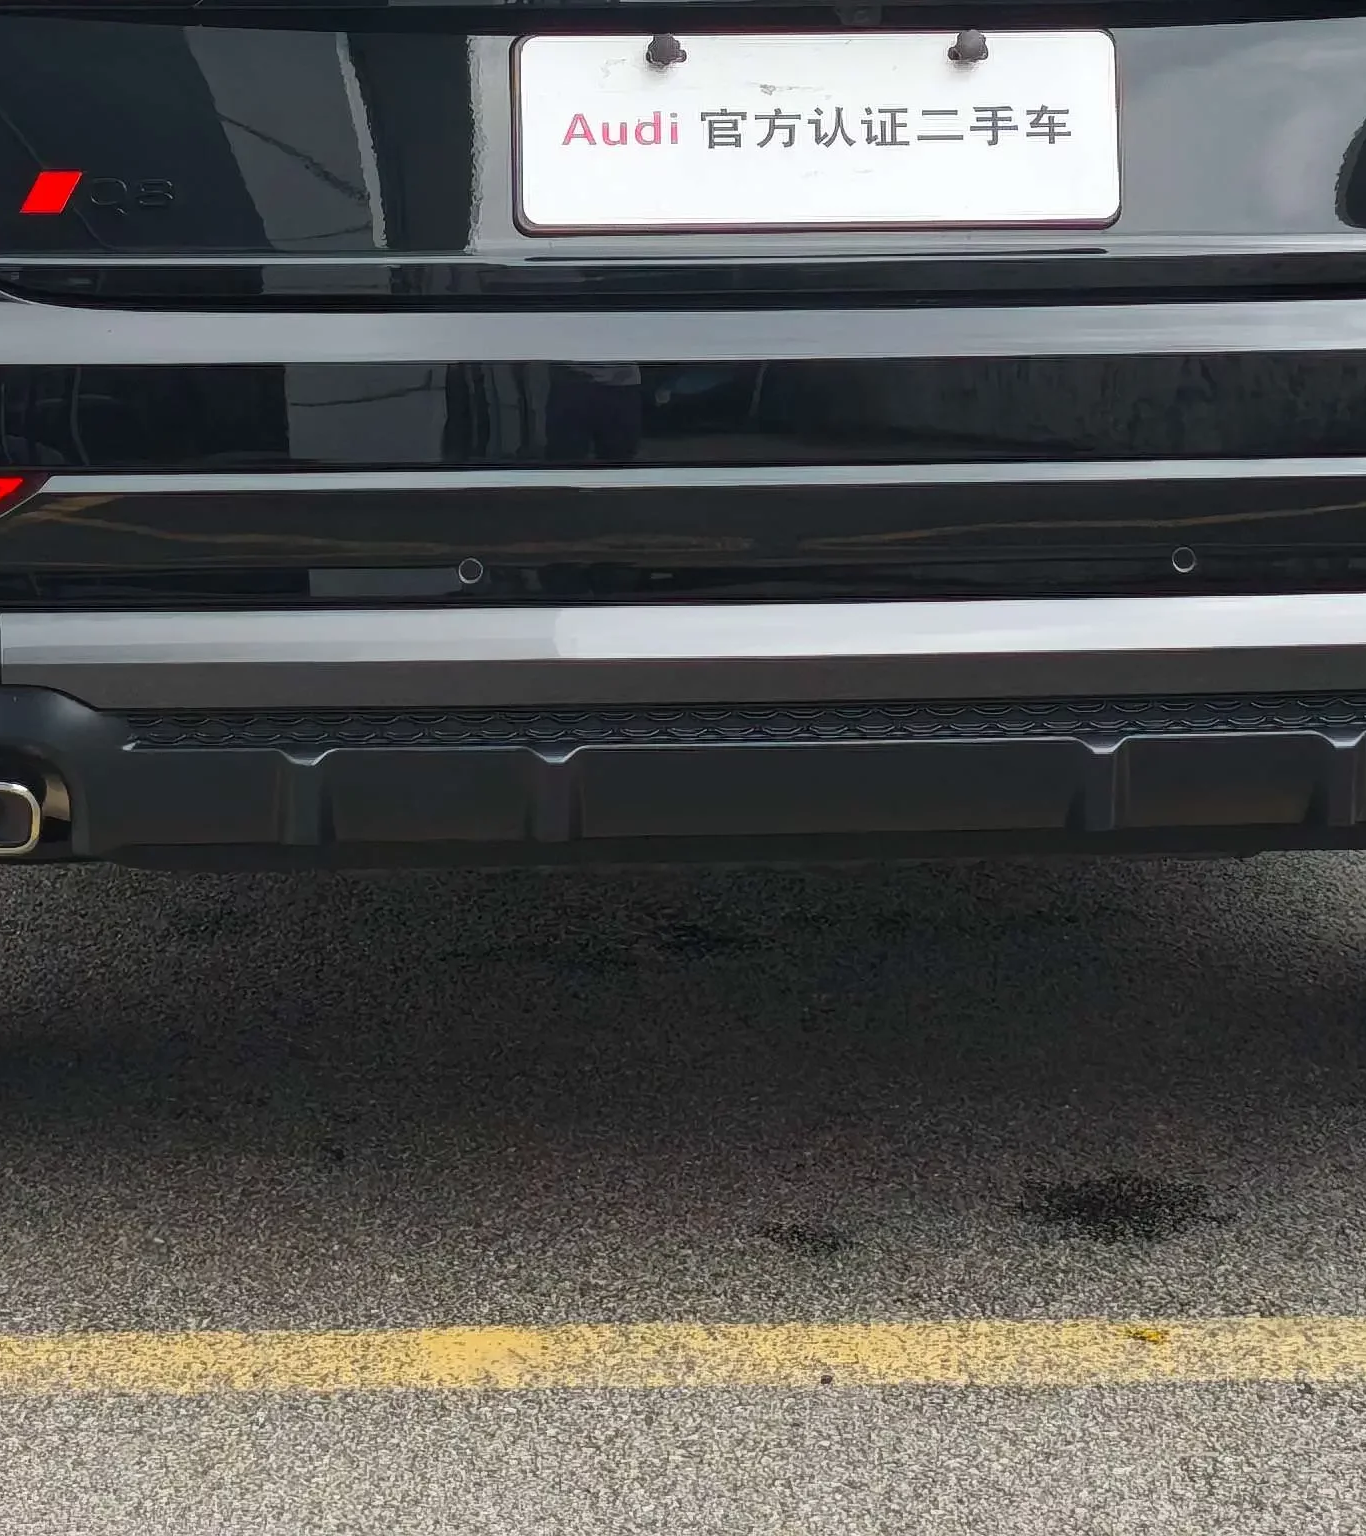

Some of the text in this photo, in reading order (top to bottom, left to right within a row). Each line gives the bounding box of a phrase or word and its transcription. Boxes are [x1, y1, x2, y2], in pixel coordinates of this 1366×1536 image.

[562, 105, 1073, 149] Audi 官方认证二手车
[89, 176, 175, 216] Q8
